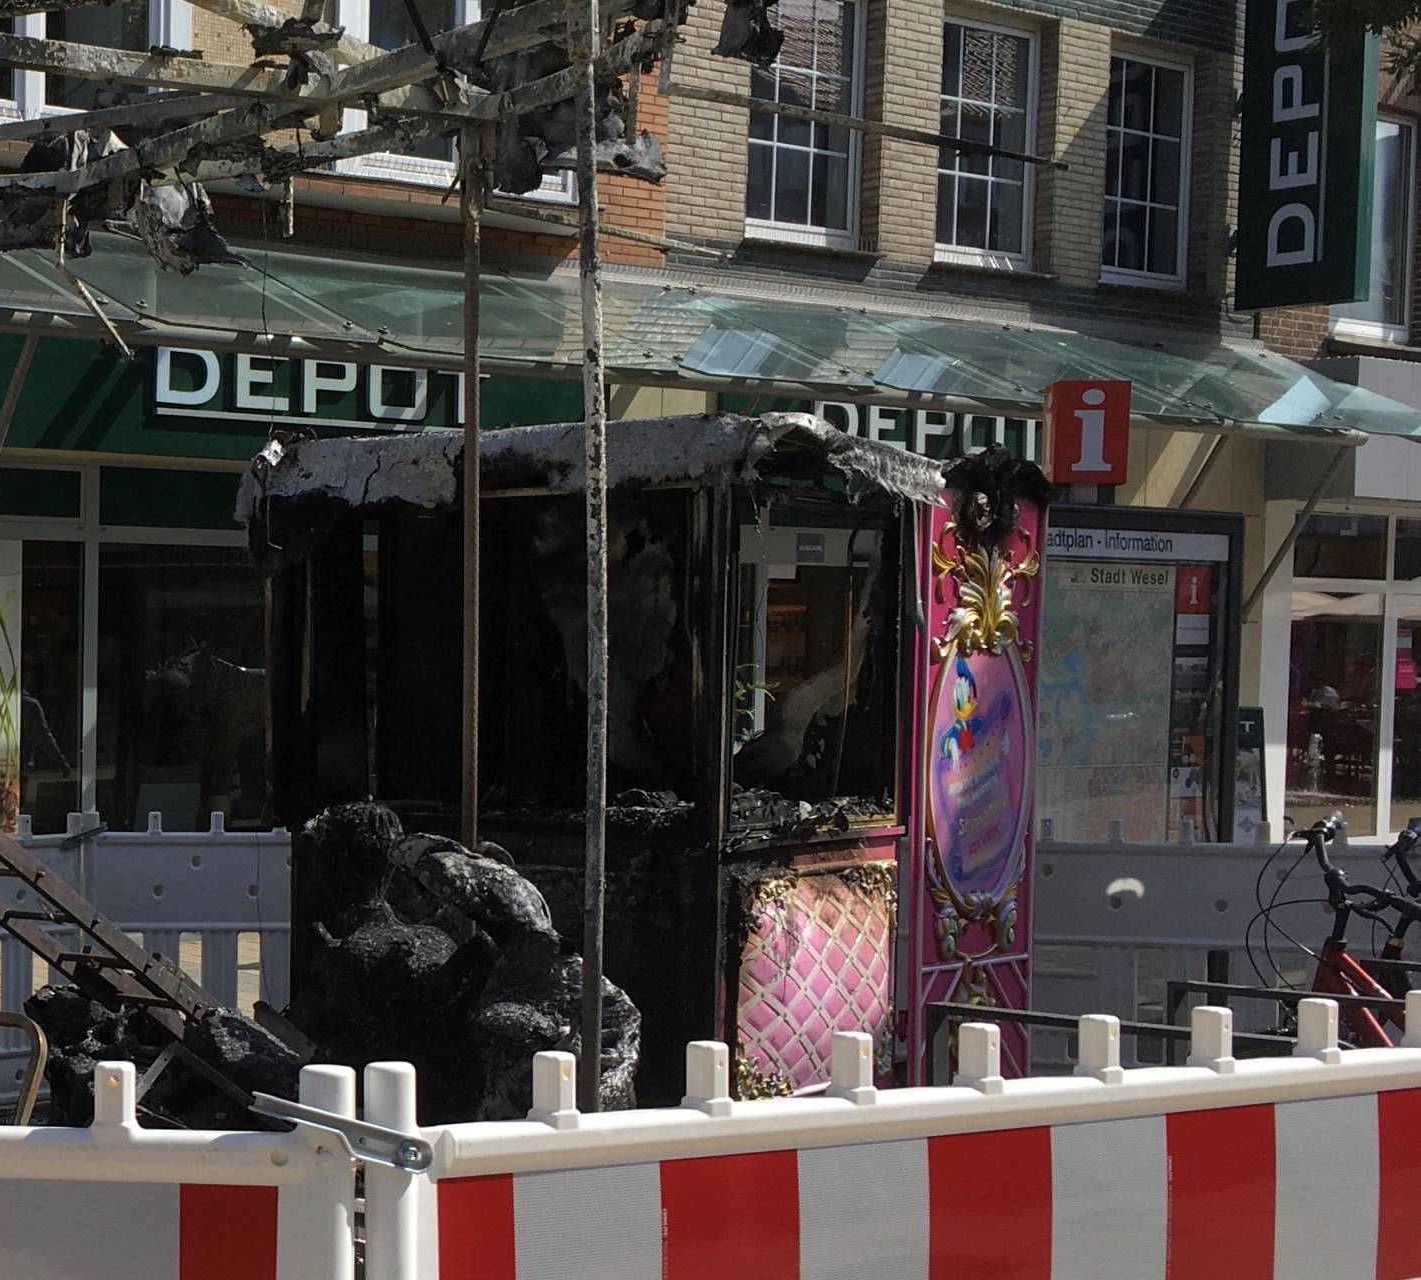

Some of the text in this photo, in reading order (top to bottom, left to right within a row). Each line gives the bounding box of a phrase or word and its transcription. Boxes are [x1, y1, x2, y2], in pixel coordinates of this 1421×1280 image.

[156, 346, 491, 424] DEPOT
[1047, 528, 1093, 551] adtplan
[1104, 529, 1174, 552] Information
[1090, 567, 1169, 586] Stadt Wesel
